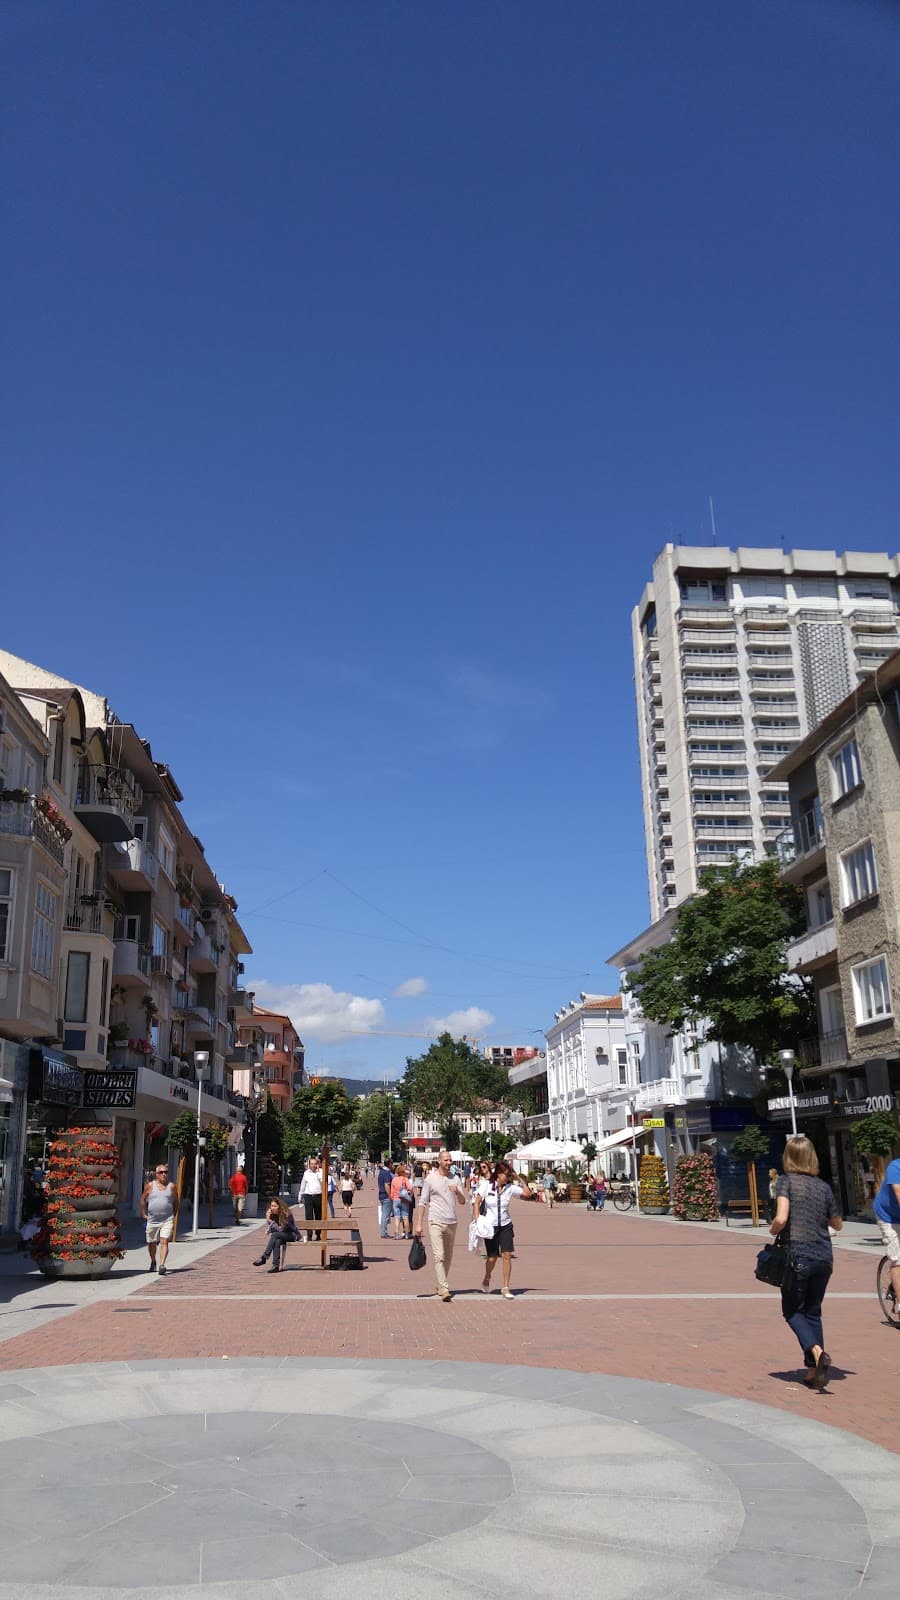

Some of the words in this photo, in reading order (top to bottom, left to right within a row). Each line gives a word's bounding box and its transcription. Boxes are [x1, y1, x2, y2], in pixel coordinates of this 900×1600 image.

[87, 1091, 132, 1105] SHOES
[813, 1096, 829, 1105] SILVER
[866, 1095, 891, 1112] 2000
